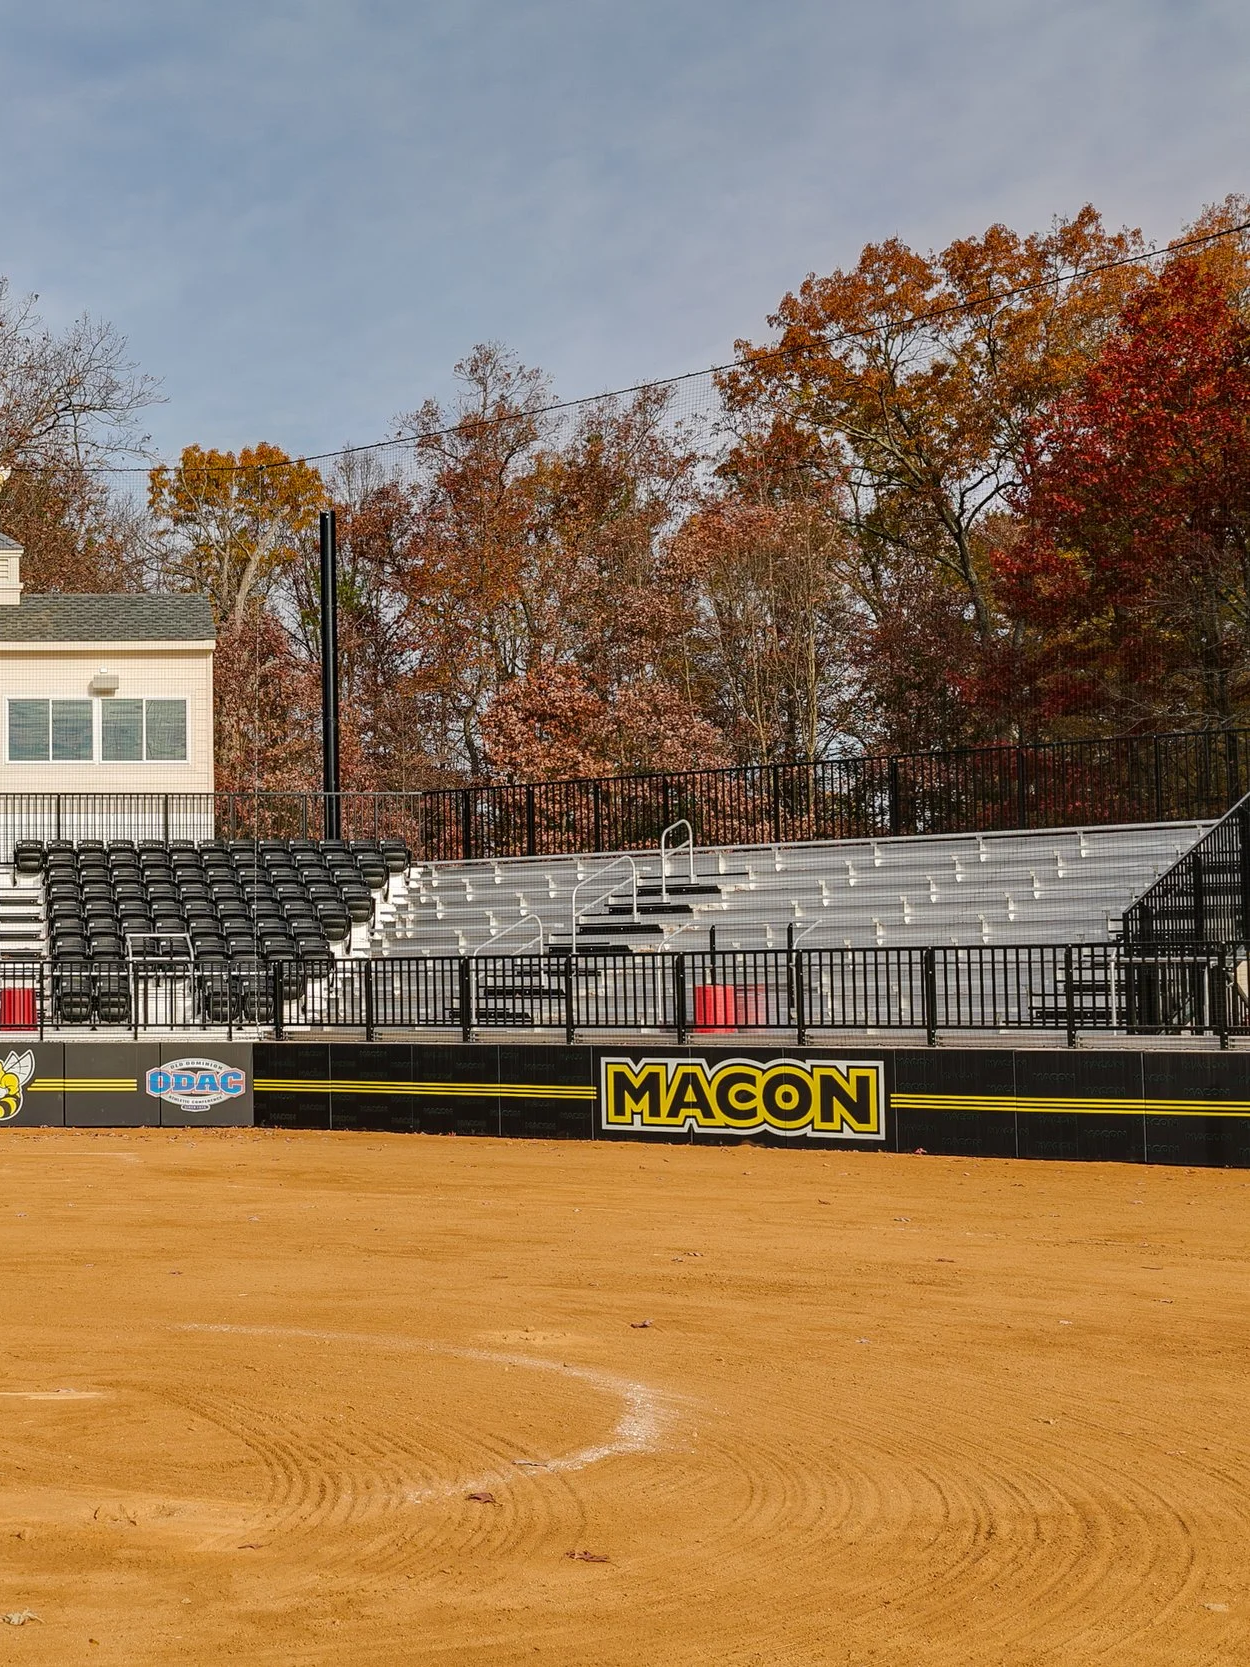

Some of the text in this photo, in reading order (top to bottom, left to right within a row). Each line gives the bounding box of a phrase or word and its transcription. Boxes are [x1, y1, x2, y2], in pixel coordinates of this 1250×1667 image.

[186, 1061, 223, 1070] DOMINION
[147, 1069, 244, 1096] ODAC
[603, 1060, 882, 1136] MACON
[1183, 1087, 1231, 1097] MACON
